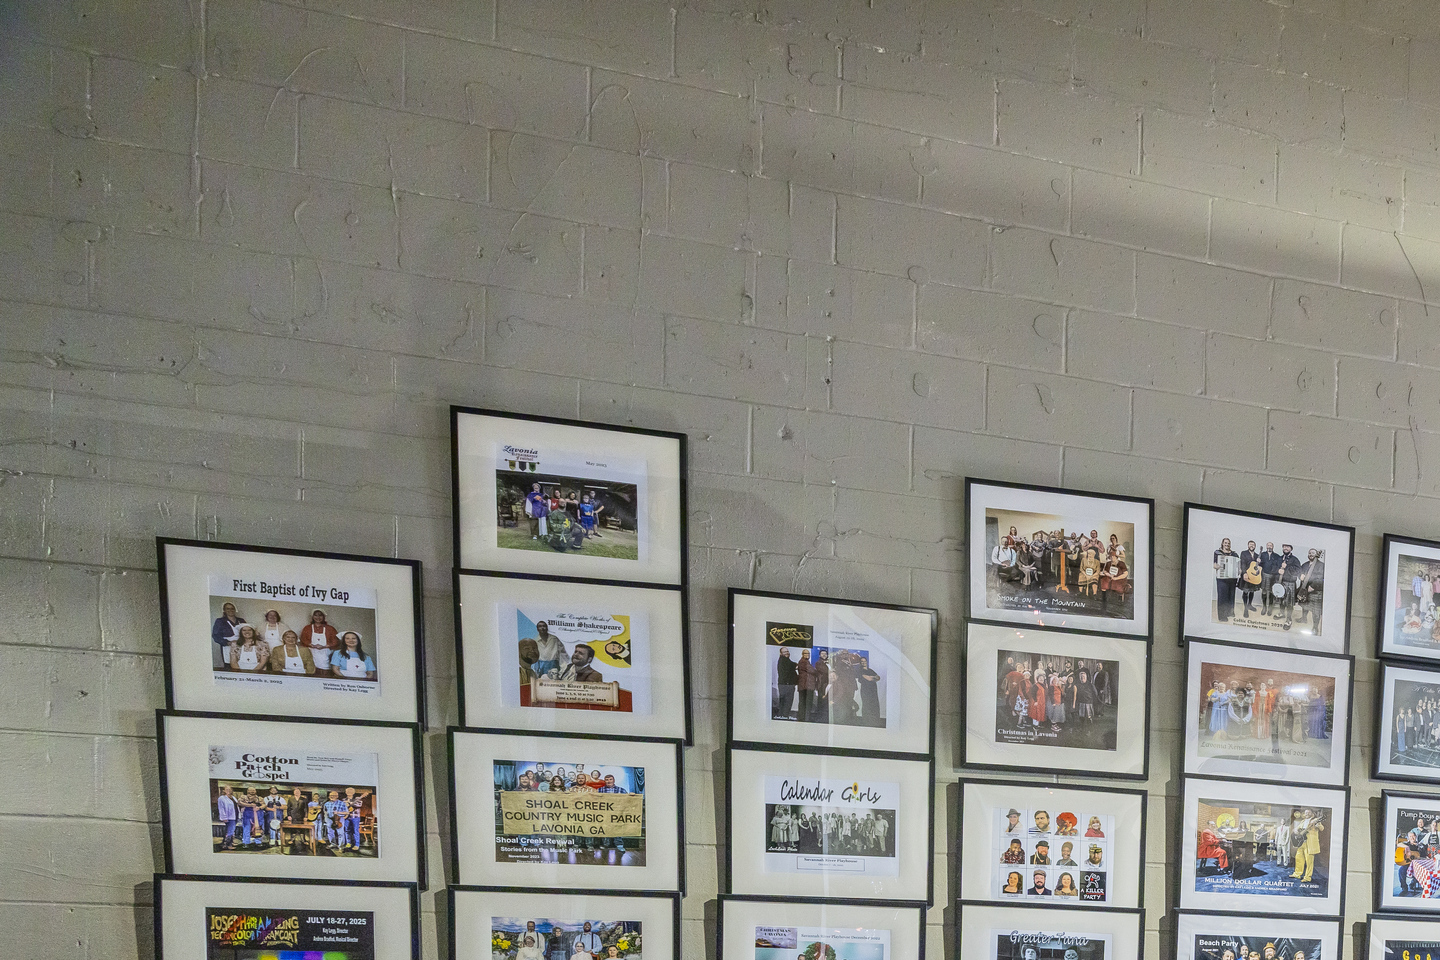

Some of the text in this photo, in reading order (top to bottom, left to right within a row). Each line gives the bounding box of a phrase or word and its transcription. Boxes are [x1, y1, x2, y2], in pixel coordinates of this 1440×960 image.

[503, 445, 538, 455] Lavonia
[233, 580, 349, 602] First Baptist of Ivy Gap
[997, 594, 1019, 602] SMOKE
[1052, 598, 1086, 608] MOUNTAIN
[577, 621, 621, 630] Shakespeare
[1035, 730, 1057, 738] Lavonia
[1201, 741, 1227, 749] Lavonia
[1228, 741, 1266, 753] Renaissance
[1267, 748, 1292, 756] Festival
[242, 753, 299, 764] Cotton
[234, 761, 281, 772] Patch
[242, 770, 289, 781] Gospel
[780, 780, 834, 803] Calendar
[526, 799, 614, 811] SHOAL CREEK
[505, 811, 641, 823] COUNTRY MUSIC PARK
[1400, 810, 1418, 820] Pump
[1419, 811, 1435, 820] Boys
[533, 824, 605, 835] LAVONIA GA
[545, 837, 575, 845] Revival
[327, 917, 348, 925] 18-27,
[1009, 930, 1089, 945] Greater Tuna
